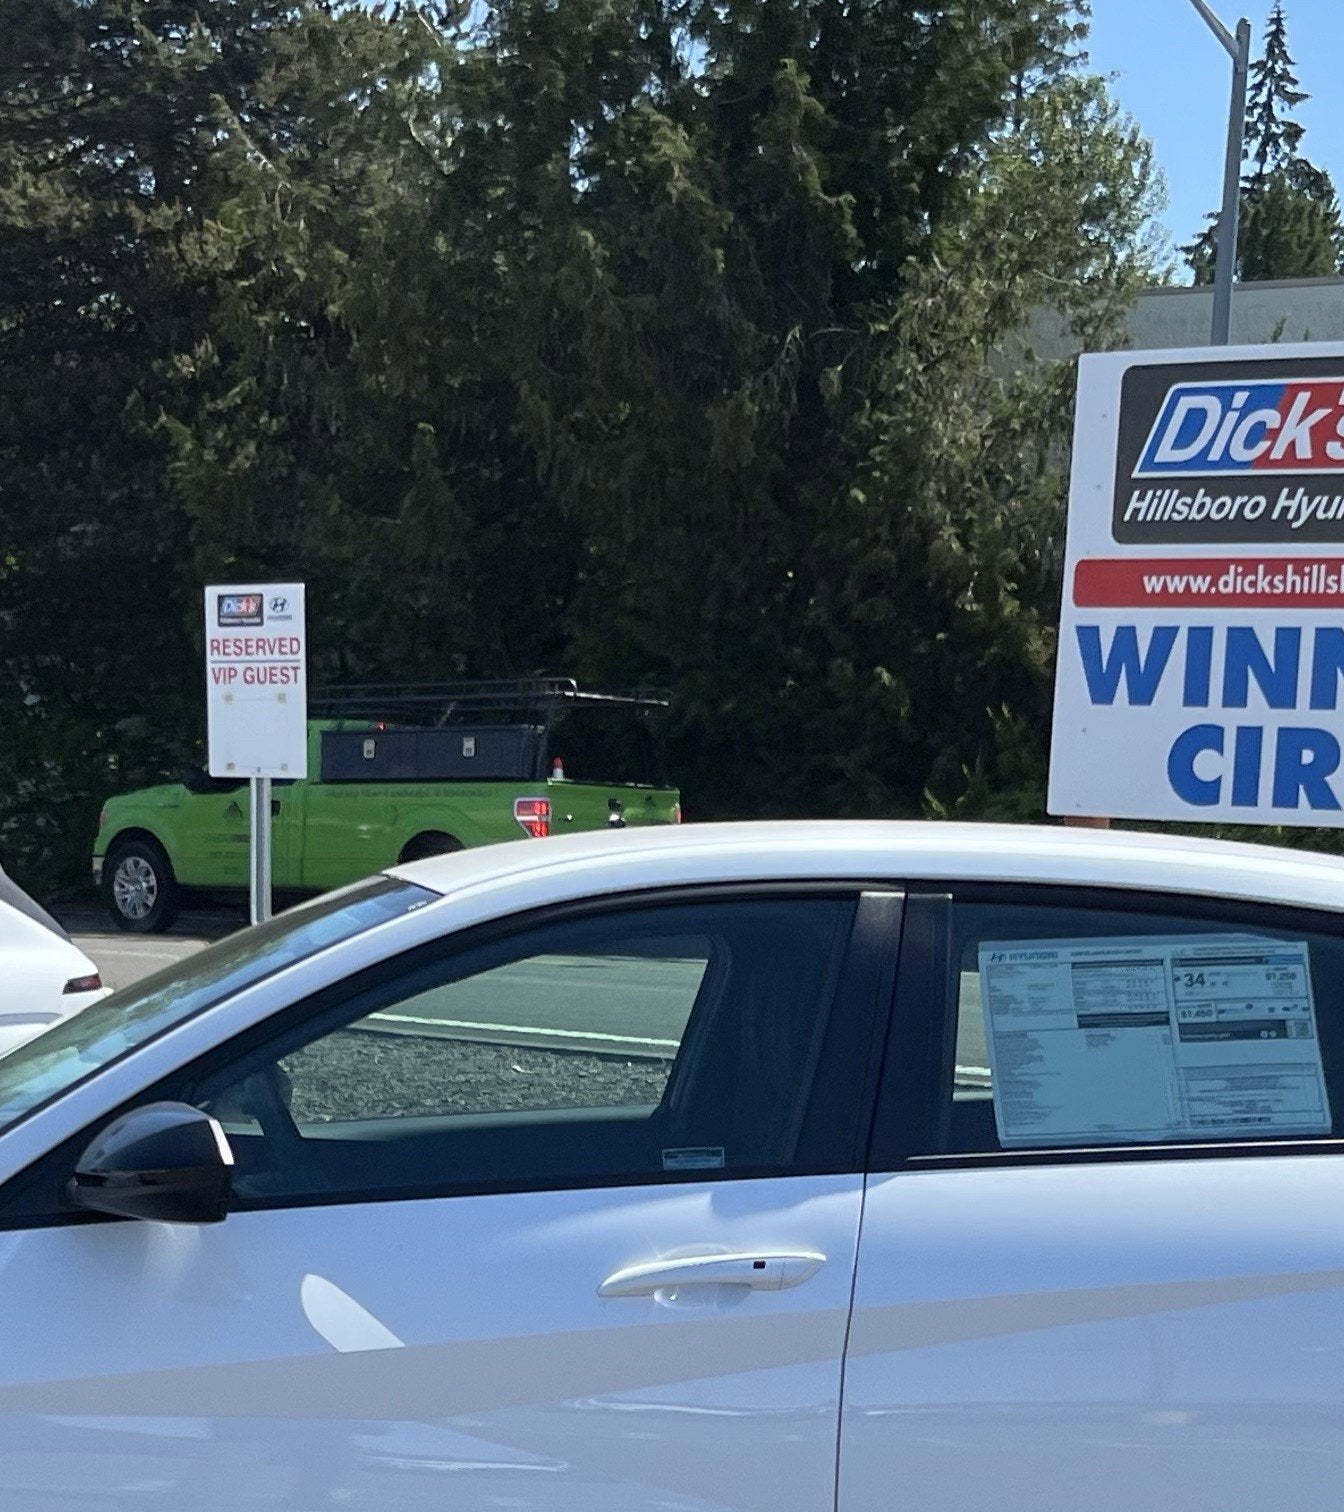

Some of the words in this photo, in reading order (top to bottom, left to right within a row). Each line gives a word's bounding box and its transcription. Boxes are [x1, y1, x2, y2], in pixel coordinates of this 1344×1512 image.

[1122, 488, 1267, 522] Hillsboro
[210, 637, 301, 657] RESERVED
[211, 667, 238, 685] VIP
[243, 666, 301, 685] GUEST
[1184, 972, 1205, 988] 34
